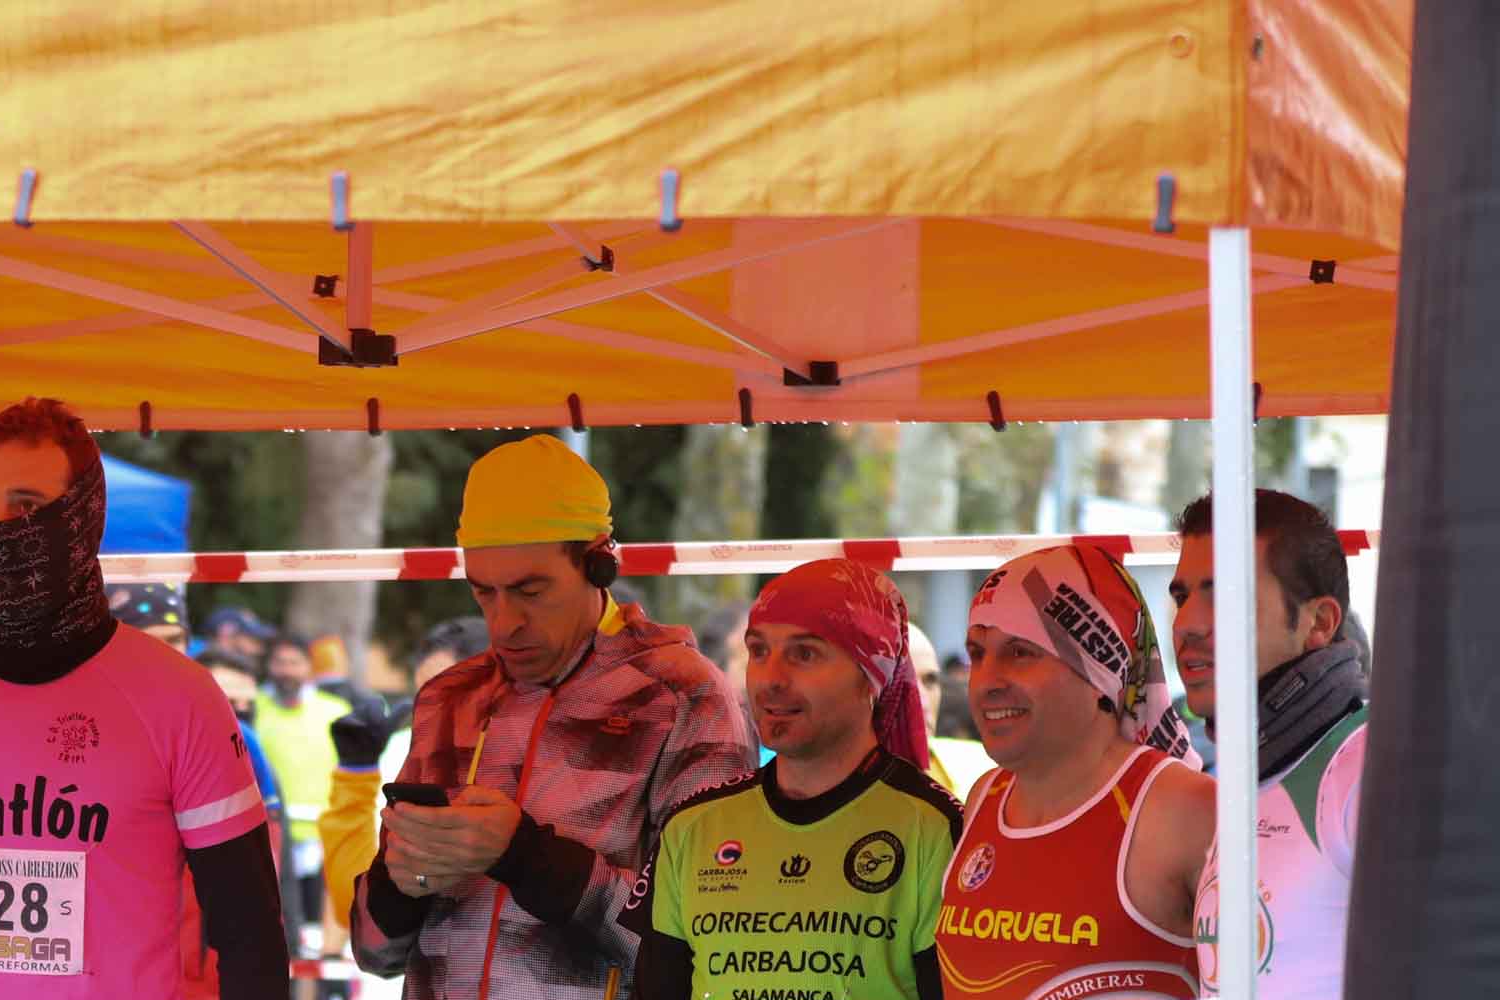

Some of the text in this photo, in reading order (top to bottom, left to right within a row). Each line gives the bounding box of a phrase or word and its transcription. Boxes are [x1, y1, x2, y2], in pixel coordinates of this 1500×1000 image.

[15, 858, 80, 879] CABRERIZOS
[691, 911, 898, 940] CORRECAMINOS
[708, 950, 866, 978] CARBAJOSA
